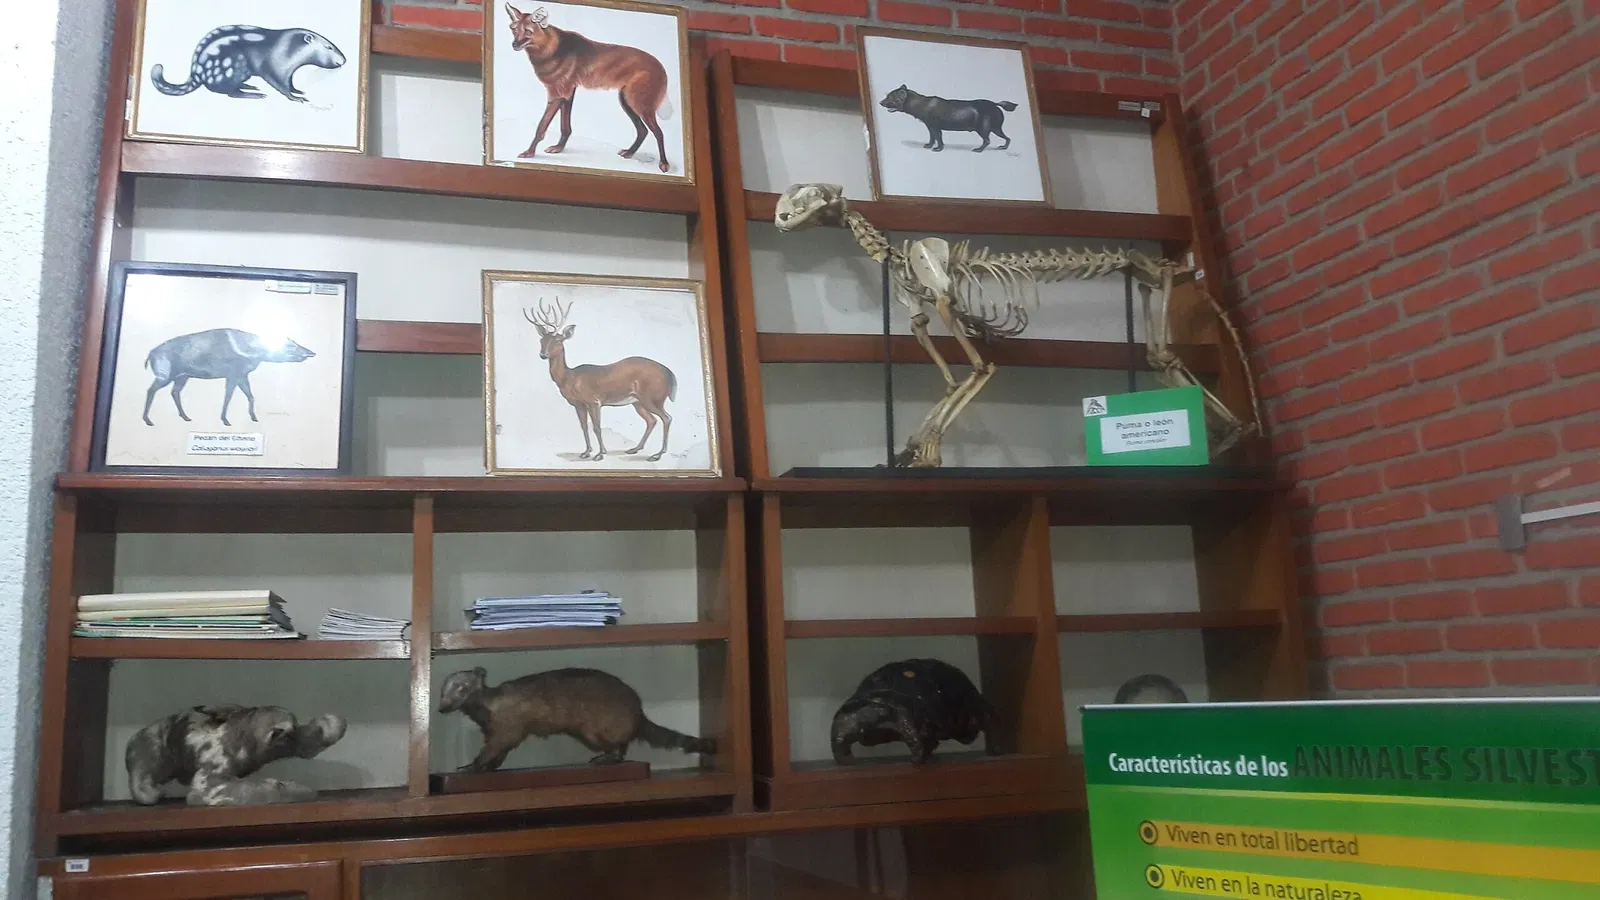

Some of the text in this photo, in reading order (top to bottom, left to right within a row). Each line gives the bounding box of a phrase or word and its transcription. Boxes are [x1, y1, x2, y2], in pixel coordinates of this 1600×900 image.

[1116, 421, 1142, 430] Puma
[1121, 428, 1170, 440] americano
[1109, 753, 1232, 777] Características
[1235, 754, 1258, 777] de
[1262, 755, 1289, 777] los
[1293, 745, 1453, 781] ANIMALES
[1165, 824, 1360, 857] Viven en total libertad
[1171, 869, 1217, 890] Viven
[1221, 877, 1243, 893] en
[1246, 875, 1260, 895] la
